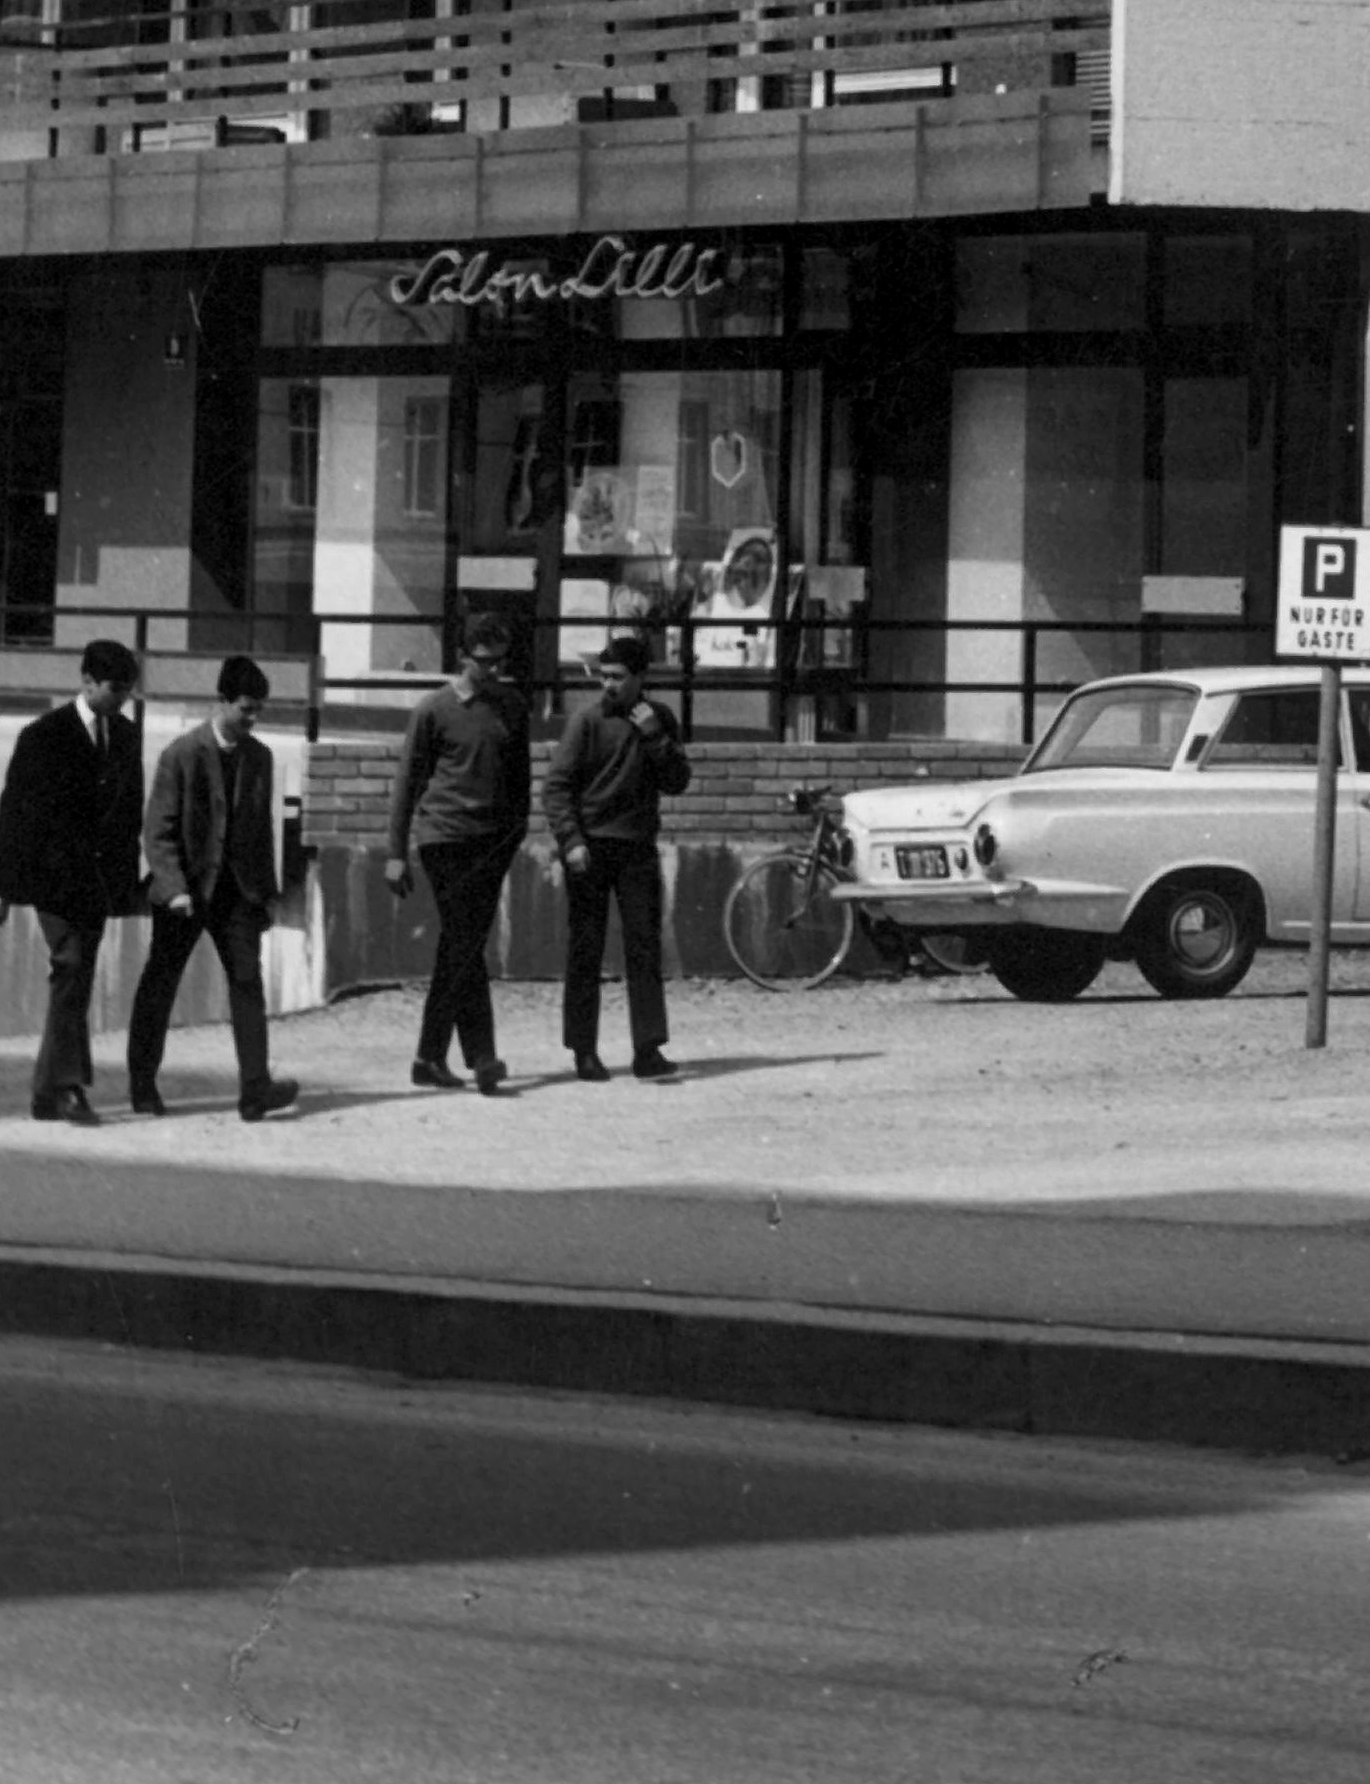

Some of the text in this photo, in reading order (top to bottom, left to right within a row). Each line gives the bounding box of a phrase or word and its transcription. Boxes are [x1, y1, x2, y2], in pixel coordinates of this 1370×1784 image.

[389, 248, 557, 306] Salon
[1315, 542, 1345, 593] P
[1289, 606, 1326, 625] NUR
